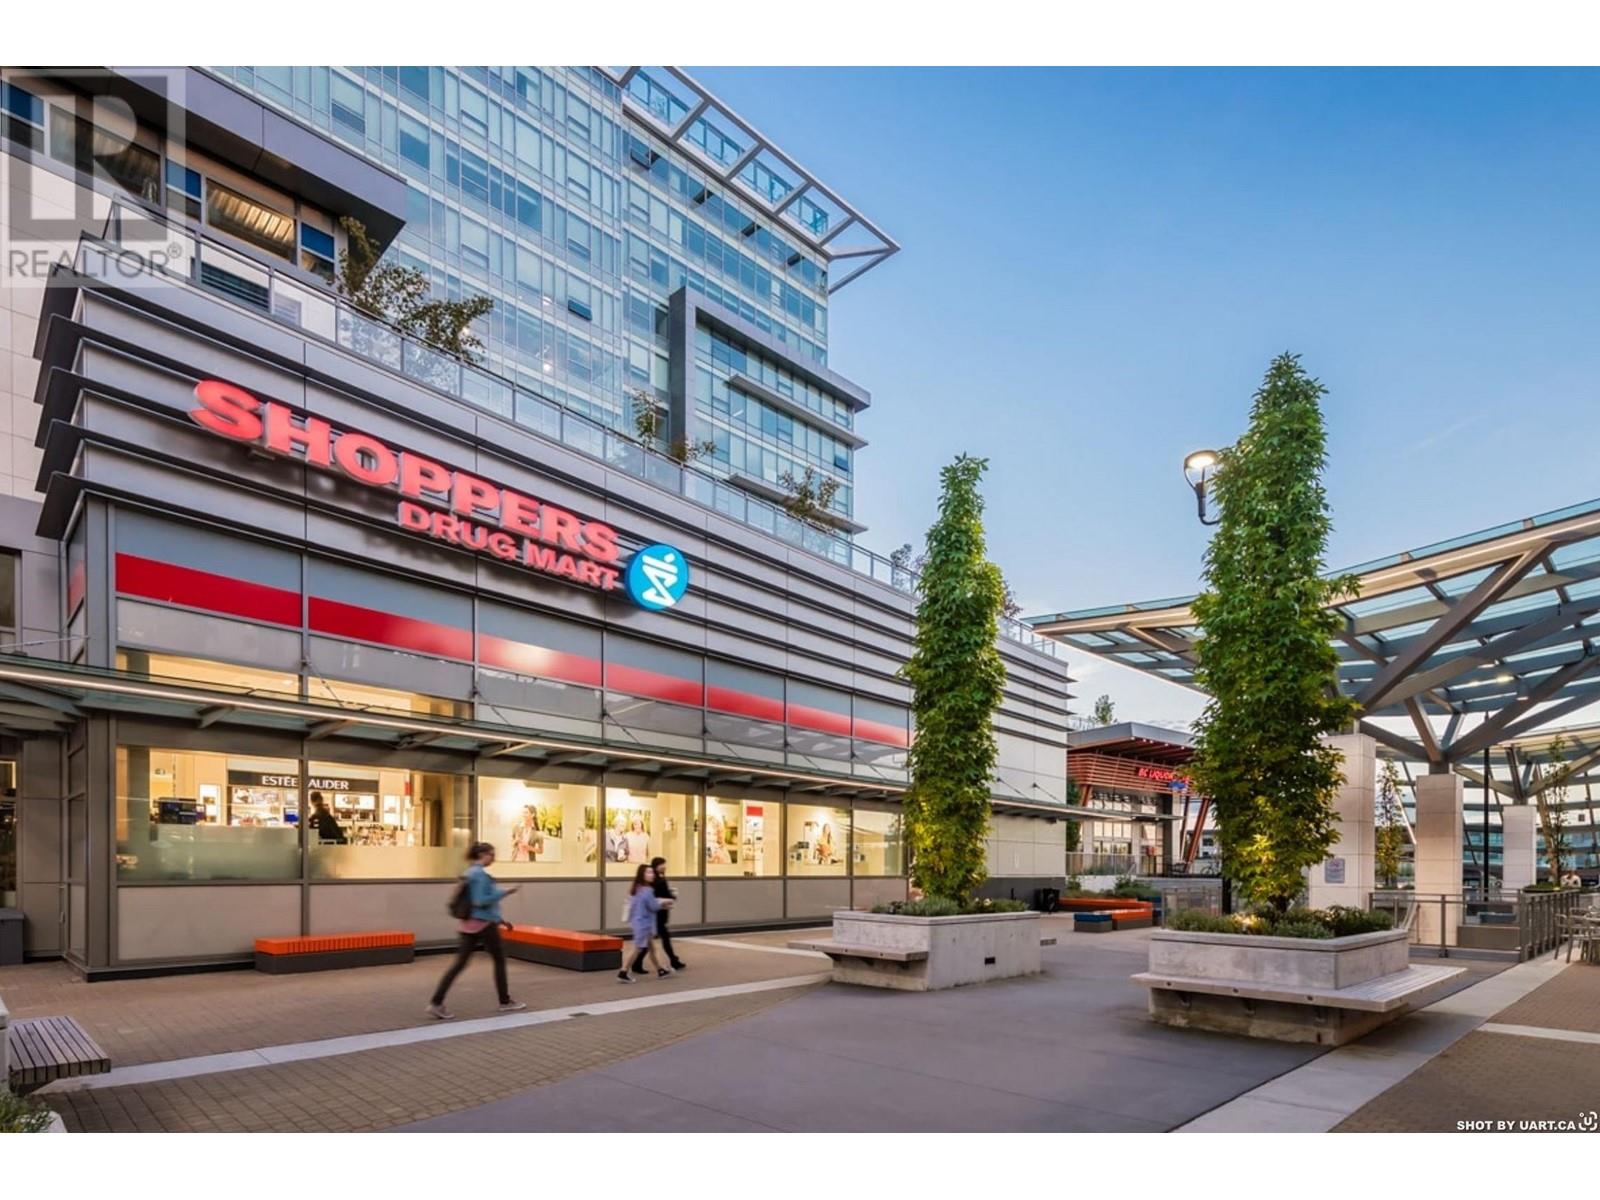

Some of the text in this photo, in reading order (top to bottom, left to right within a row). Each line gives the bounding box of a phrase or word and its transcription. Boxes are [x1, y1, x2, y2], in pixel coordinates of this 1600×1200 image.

[187, 379, 620, 564] SHOPPERS
[397, 500, 620, 591] DRUG MART
[305, 778, 349, 790] AUDER
